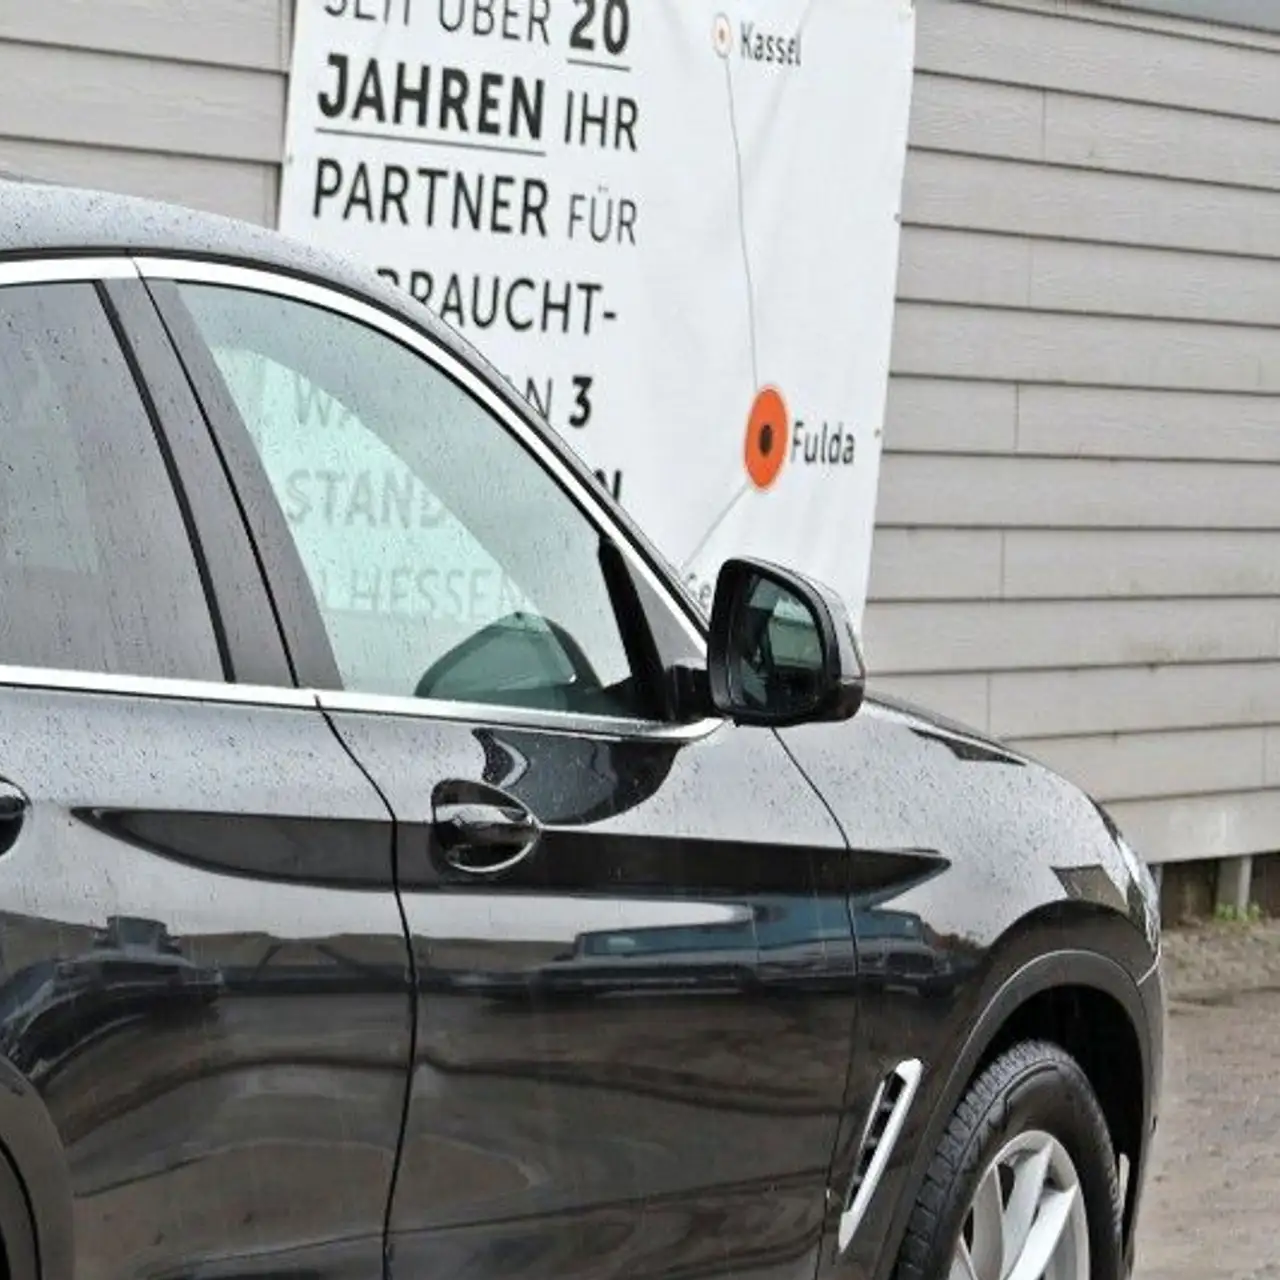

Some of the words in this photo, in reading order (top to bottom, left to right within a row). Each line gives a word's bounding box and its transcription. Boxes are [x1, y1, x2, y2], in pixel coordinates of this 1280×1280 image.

[568, 0, 631, 55] 20
[740, 20, 801, 67] Kassel
[317, 52, 545, 140] JAHREN
[563, 89, 639, 153] IHR
[312, 156, 549, 238] PARTNER
[567, 184, 638, 247] FÜR
[376, 266, 617, 337] RAUCHT-
[568, 375, 594, 429] 3
[790, 419, 854, 465] Fulda
